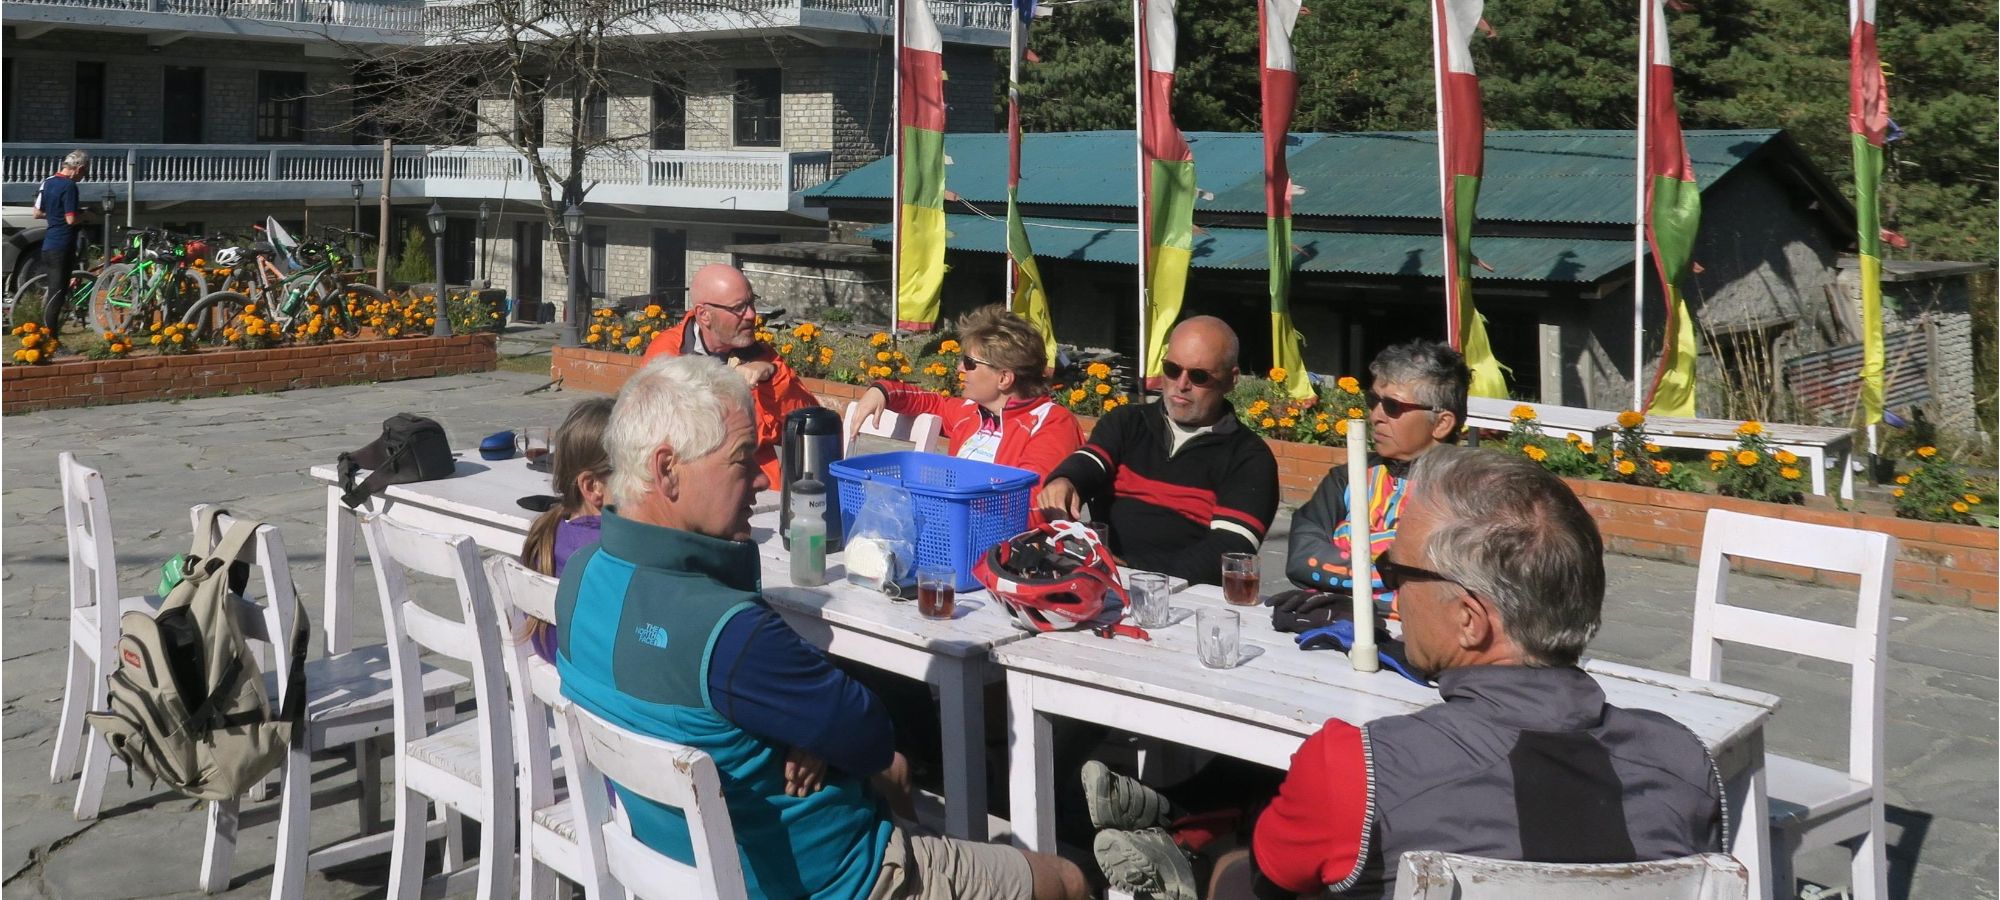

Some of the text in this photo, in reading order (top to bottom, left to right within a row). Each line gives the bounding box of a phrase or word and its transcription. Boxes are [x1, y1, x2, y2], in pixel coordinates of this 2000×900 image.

[635, 625, 658, 639] NORTH
[646, 623, 660, 632] THE
[638, 634, 656, 646] FACE
